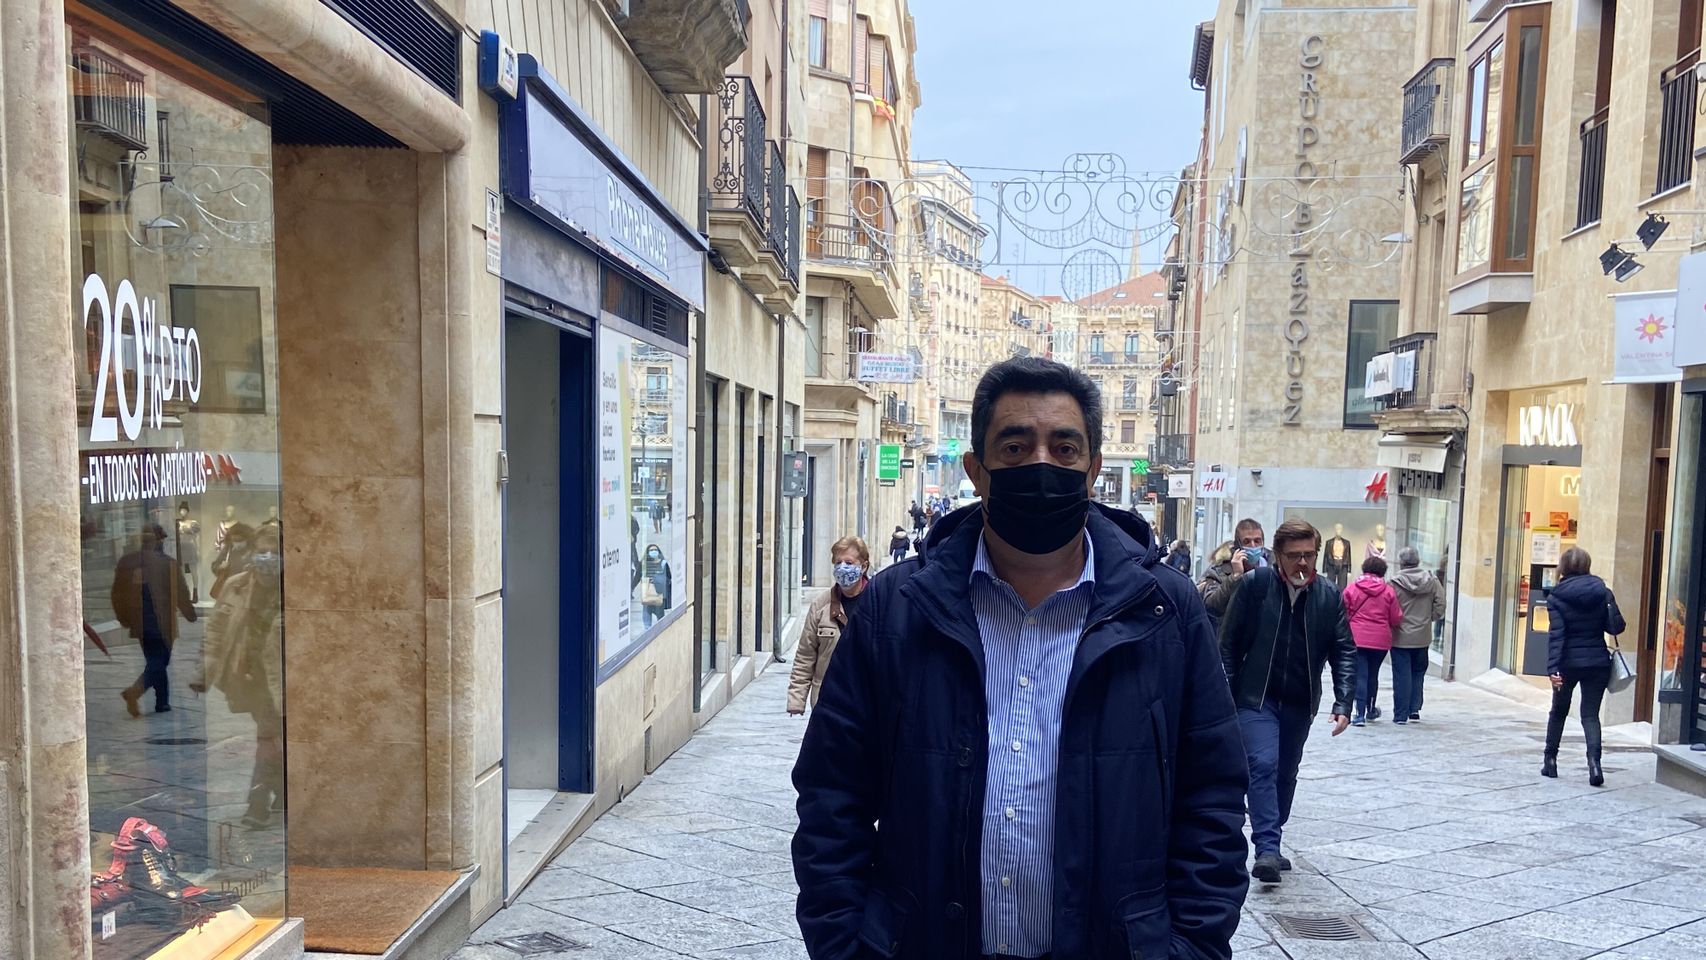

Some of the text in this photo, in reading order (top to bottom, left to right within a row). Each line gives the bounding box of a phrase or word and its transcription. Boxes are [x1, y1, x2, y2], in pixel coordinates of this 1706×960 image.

[1294, 34, 1324, 185] GRUPO
[82, 273, 202, 442] 20% DTO
[104, 453, 139, 502] TODOS
[139, 453, 159, 500] LOS
